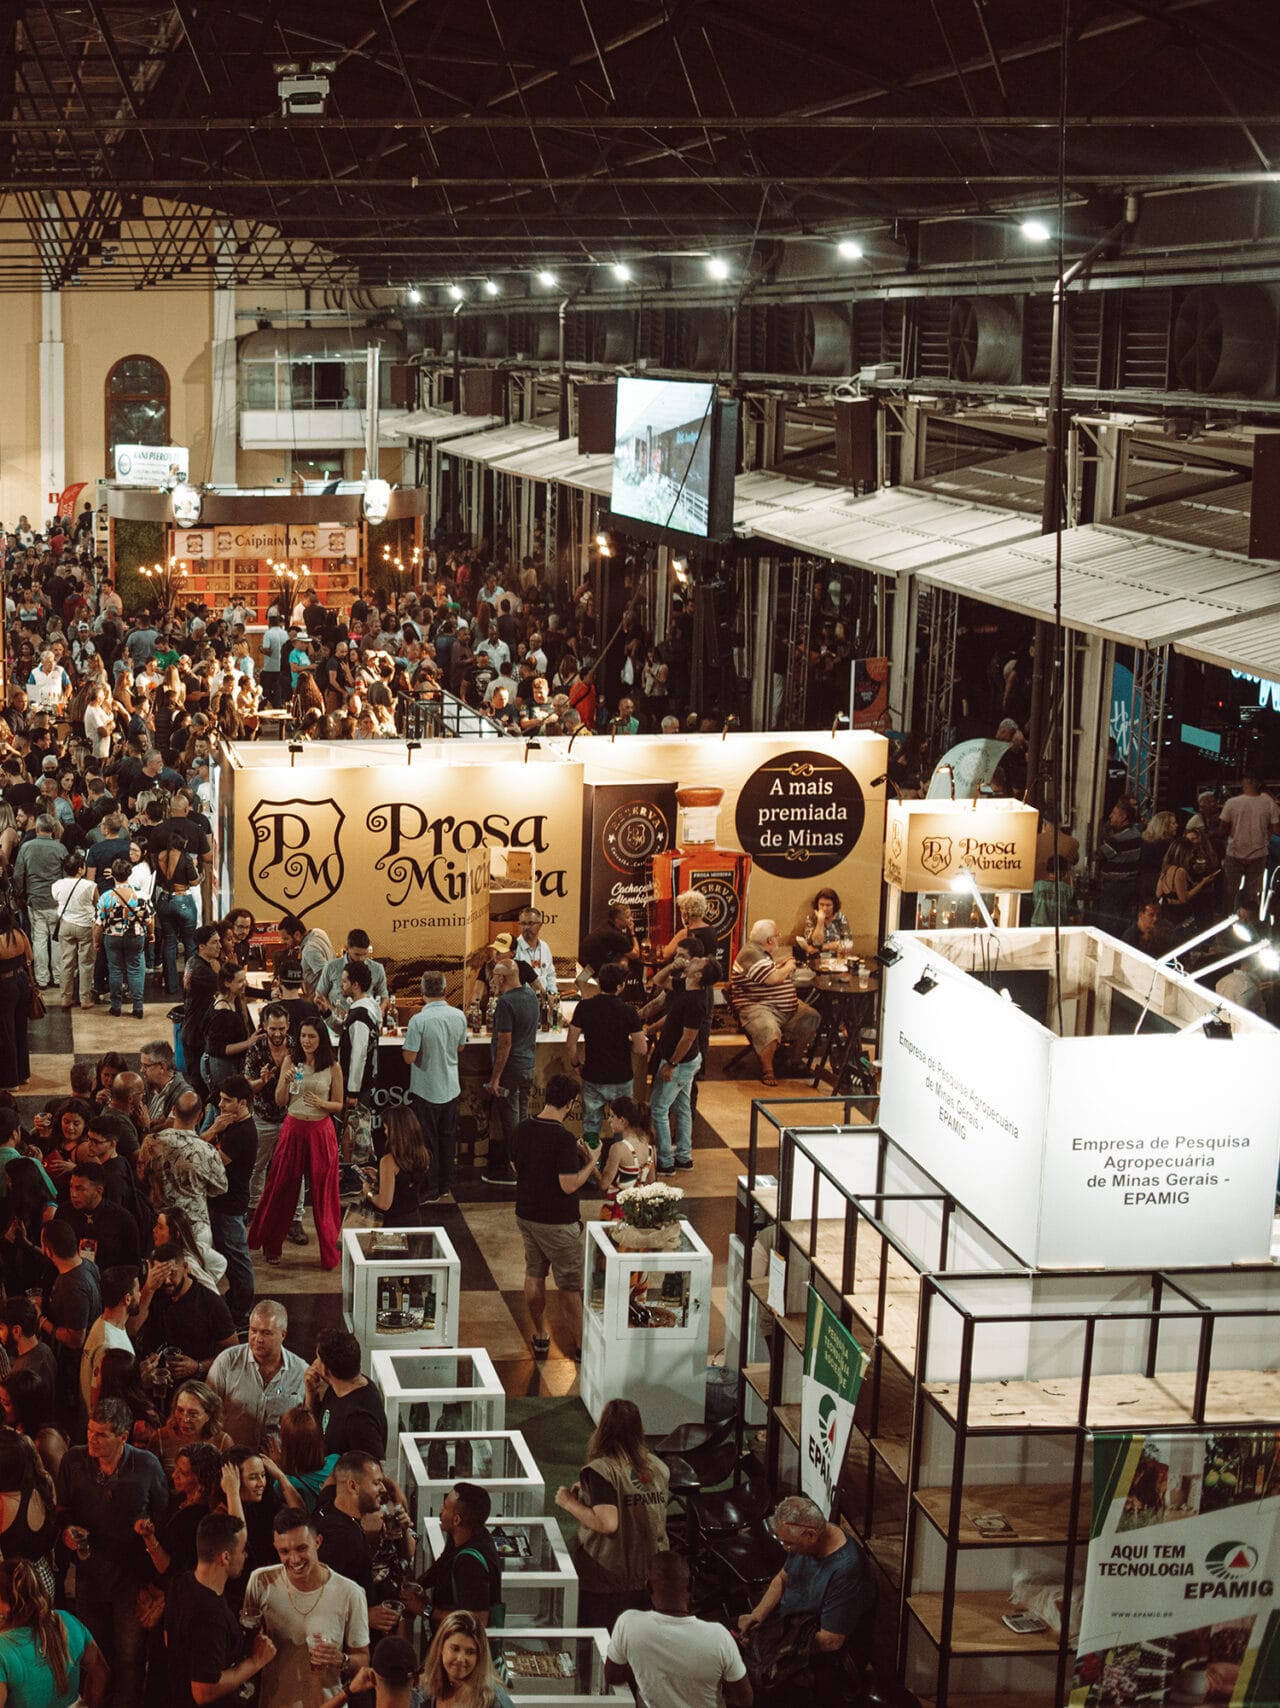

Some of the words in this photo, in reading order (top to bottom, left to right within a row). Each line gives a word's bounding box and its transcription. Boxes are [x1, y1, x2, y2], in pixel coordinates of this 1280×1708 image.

[769, 778, 784, 795] A
[789, 777, 833, 795] mais
[758, 802, 848, 826] premiada
[366, 802, 549, 871] Prosa
[760, 829, 782, 847] de
[788, 829, 844, 847] Minas
[959, 838, 1017, 856] Prosa
[958, 854, 1022, 871] Mineira
[700, 883, 734, 903] SERVA
[899, 1030, 927, 1064] Empresa
[927, 1057, 936, 1072] de
[925, 1075, 934, 1091] de
[935, 1081, 955, 1109] Minas
[938, 1105, 967, 1140] EPAMIG
[1072, 1137, 1144, 1153] Empresa
[1150, 1136, 1169, 1149] de
[1175, 1135, 1250, 1150] Pesquisa
[1104, 1154, 1215, 1171] Agropecuária
[1087, 1175, 1106, 1188] de
[1112, 1174, 1160, 1187] Minas
[1166, 1172, 1218, 1186] Gerais
[1124, 1191, 1190, 1205] EPAMIG
[623, 1491, 665, 1506] EPAMIG
[1110, 1545, 1148, 1561] AQUI
[1153, 1545, 1186, 1558] TEM
[1098, 1563, 1195, 1576] TECNOLOGIA
[1184, 1579, 1274, 1599] EPAMIG
